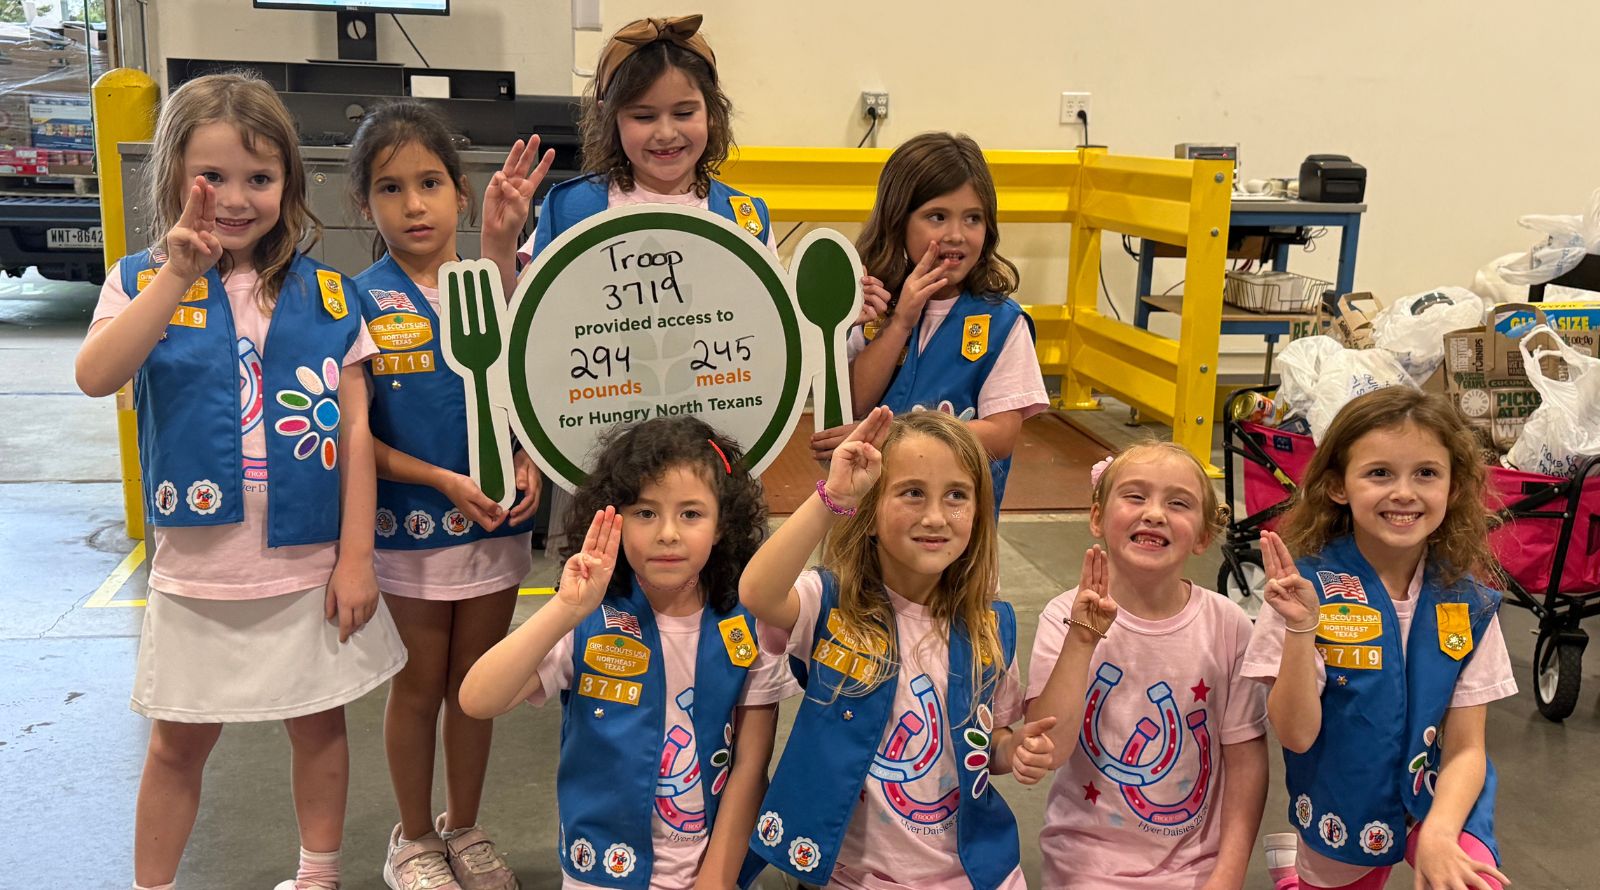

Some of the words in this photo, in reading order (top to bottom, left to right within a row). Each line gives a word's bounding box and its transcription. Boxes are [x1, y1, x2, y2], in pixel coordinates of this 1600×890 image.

[600, 240, 683, 272] Troop
[602, 275, 684, 310] 3719
[178, 308, 204, 325] 19
[574, 316, 652, 338] provided
[657, 312, 712, 328] access
[716, 310, 734, 323] to
[1558, 316, 1589, 332] SIZE
[387, 322, 414, 330] SCOUTS
[381, 332, 420, 341] NORTHEAST
[690, 335, 755, 371] 245
[376, 354, 430, 371] 3719
[570, 346, 631, 380] 294
[696, 368, 751, 387] meals
[569, 380, 642, 403] pounds
[559, 413, 583, 428] for
[589, 405, 650, 424] Hungry
[656, 400, 703, 418] North
[708, 394, 763, 412] Texans
[590, 642, 603, 651] GIRL
[606, 645, 633, 655] SCOUTS
[634, 651, 646, 659] USA
[596, 655, 636, 667] NORTHEAST
[604, 663, 625, 672] TEXAS
[584, 677, 638, 701] 3719
[1163, 824, 1195, 836] Daisies
